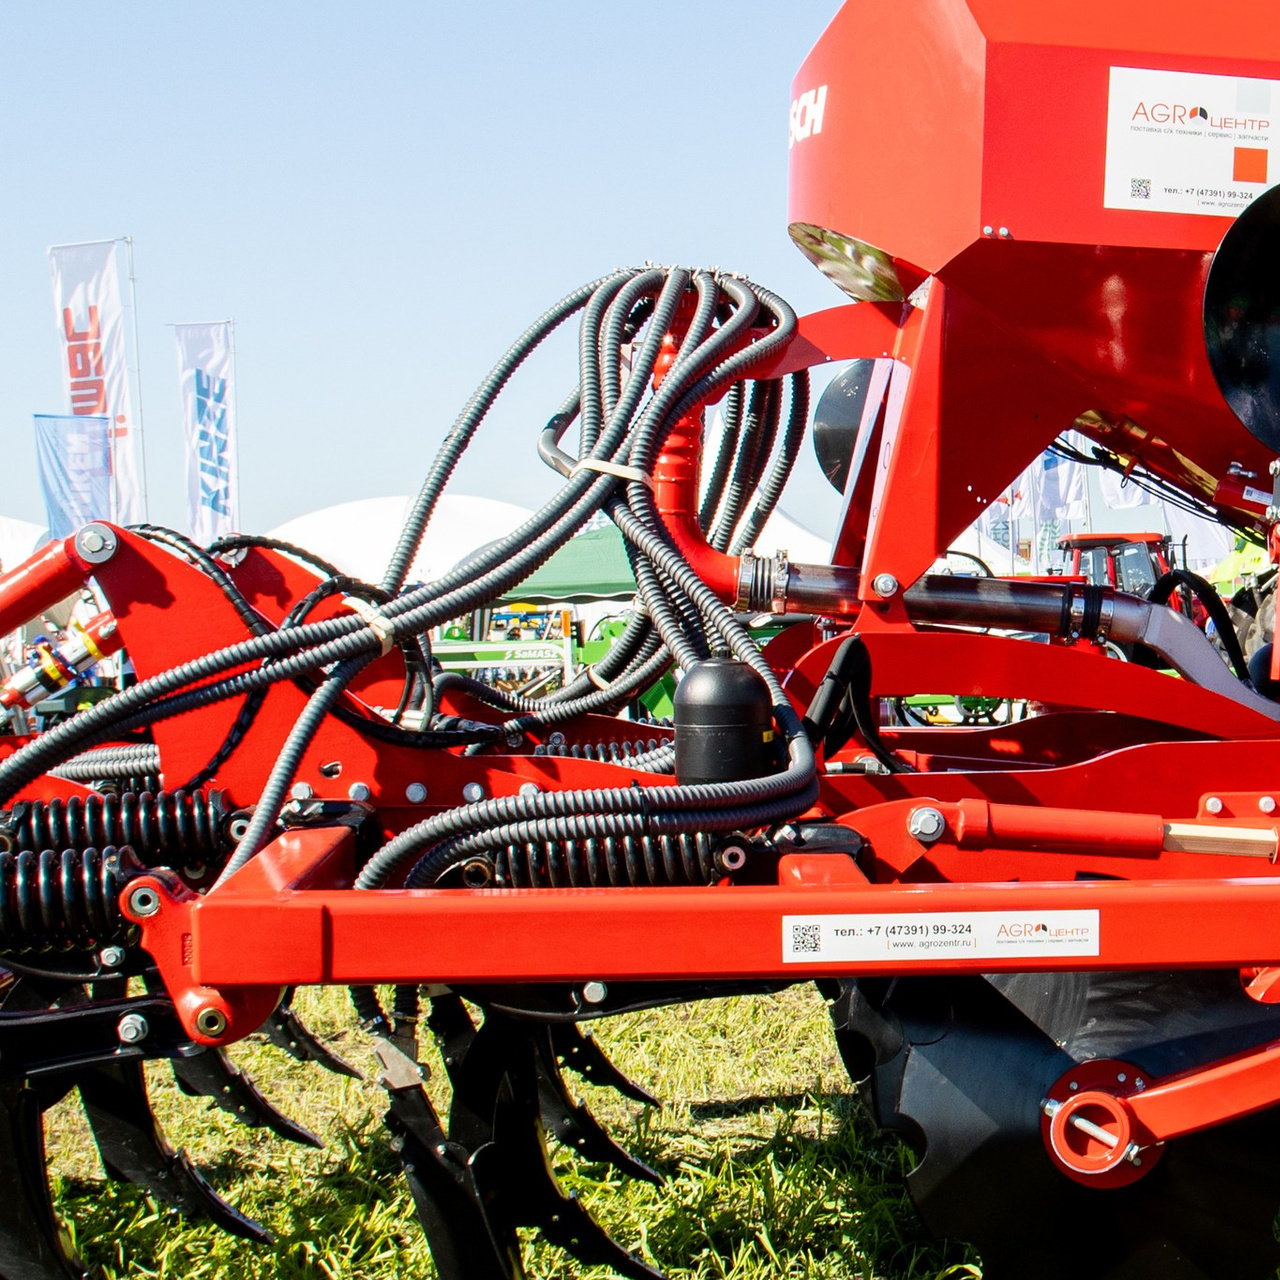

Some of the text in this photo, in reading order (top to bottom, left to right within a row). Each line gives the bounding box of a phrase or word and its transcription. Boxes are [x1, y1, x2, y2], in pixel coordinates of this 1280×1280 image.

[789, 85, 827, 149] SCH
[1130, 125, 1161, 133] поставка
[1175, 128, 1202, 136] техники
[1237, 133, 1269, 141] запчасти
[1196, 189, 1225, 199] (47391)
[1227, 190, 1253, 199] 99-324
[195, 368, 231, 516] KINZE
[834, 924, 972, 938] тел.: +7 (47391) 99-324
[919, 939, 972, 949] agrozentr.ru
